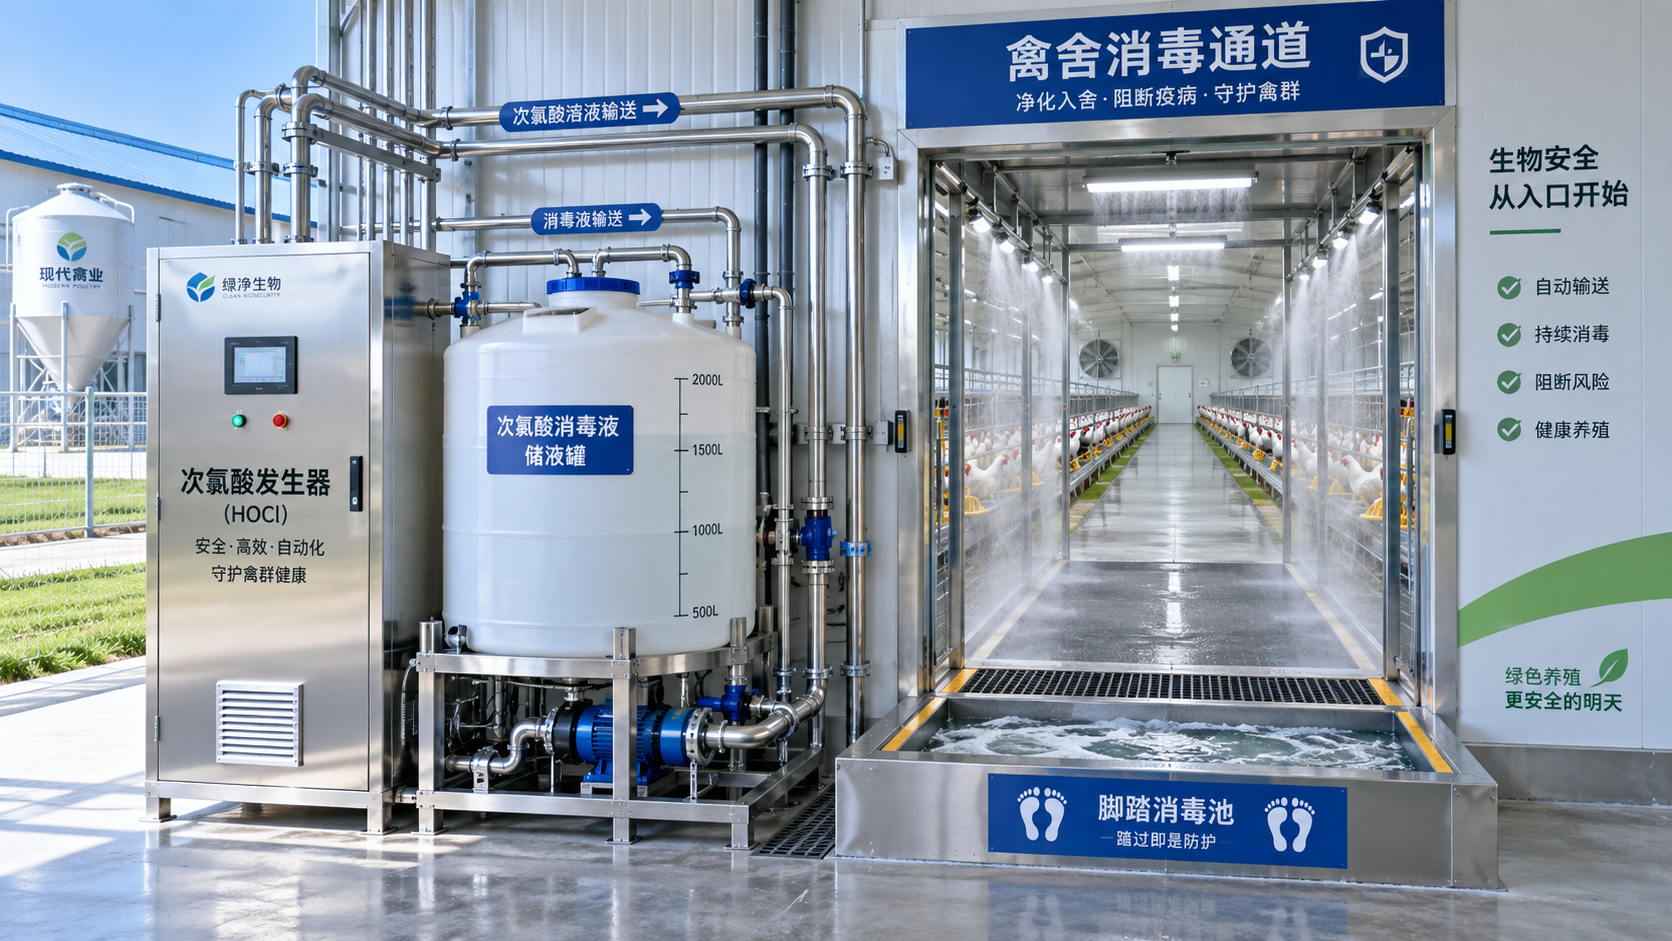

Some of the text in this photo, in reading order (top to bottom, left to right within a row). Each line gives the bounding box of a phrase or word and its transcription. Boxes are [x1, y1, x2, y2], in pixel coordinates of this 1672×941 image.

[1006, 20, 1311, 82] 禽舍消毒通道
[1489, 144, 1599, 174] 生物安全
[1489, 180, 1629, 210] 从入口开始
[543, 210, 623, 230] 消毒液输送
[39, 266, 104, 282] 现代禽业
[1536, 276, 1610, 296] 自动输送
[1534, 324, 1610, 344] 持续消毒
[692, 373, 723, 386] 2000L
[1535, 372, 1610, 392] 阻断风险
[497, 414, 620, 438] 次氯酸消毒液
[1535, 420, 1611, 440] 健康养殖
[525, 444, 587, 467] 储液罐
[692, 443, 723, 456] 1500L
[181, 467, 331, 497] 次氯酸发生器
[692, 523, 723, 536] 1000L
[211, 565, 307, 584] 守护禽群健康
[692, 605, 719, 619] 500L
[1505, 666, 1581, 686] 绿色养殖
[1505, 690, 1622, 712] 更安全的明天
[1098, 794, 1235, 825] 脚踏消毒池
